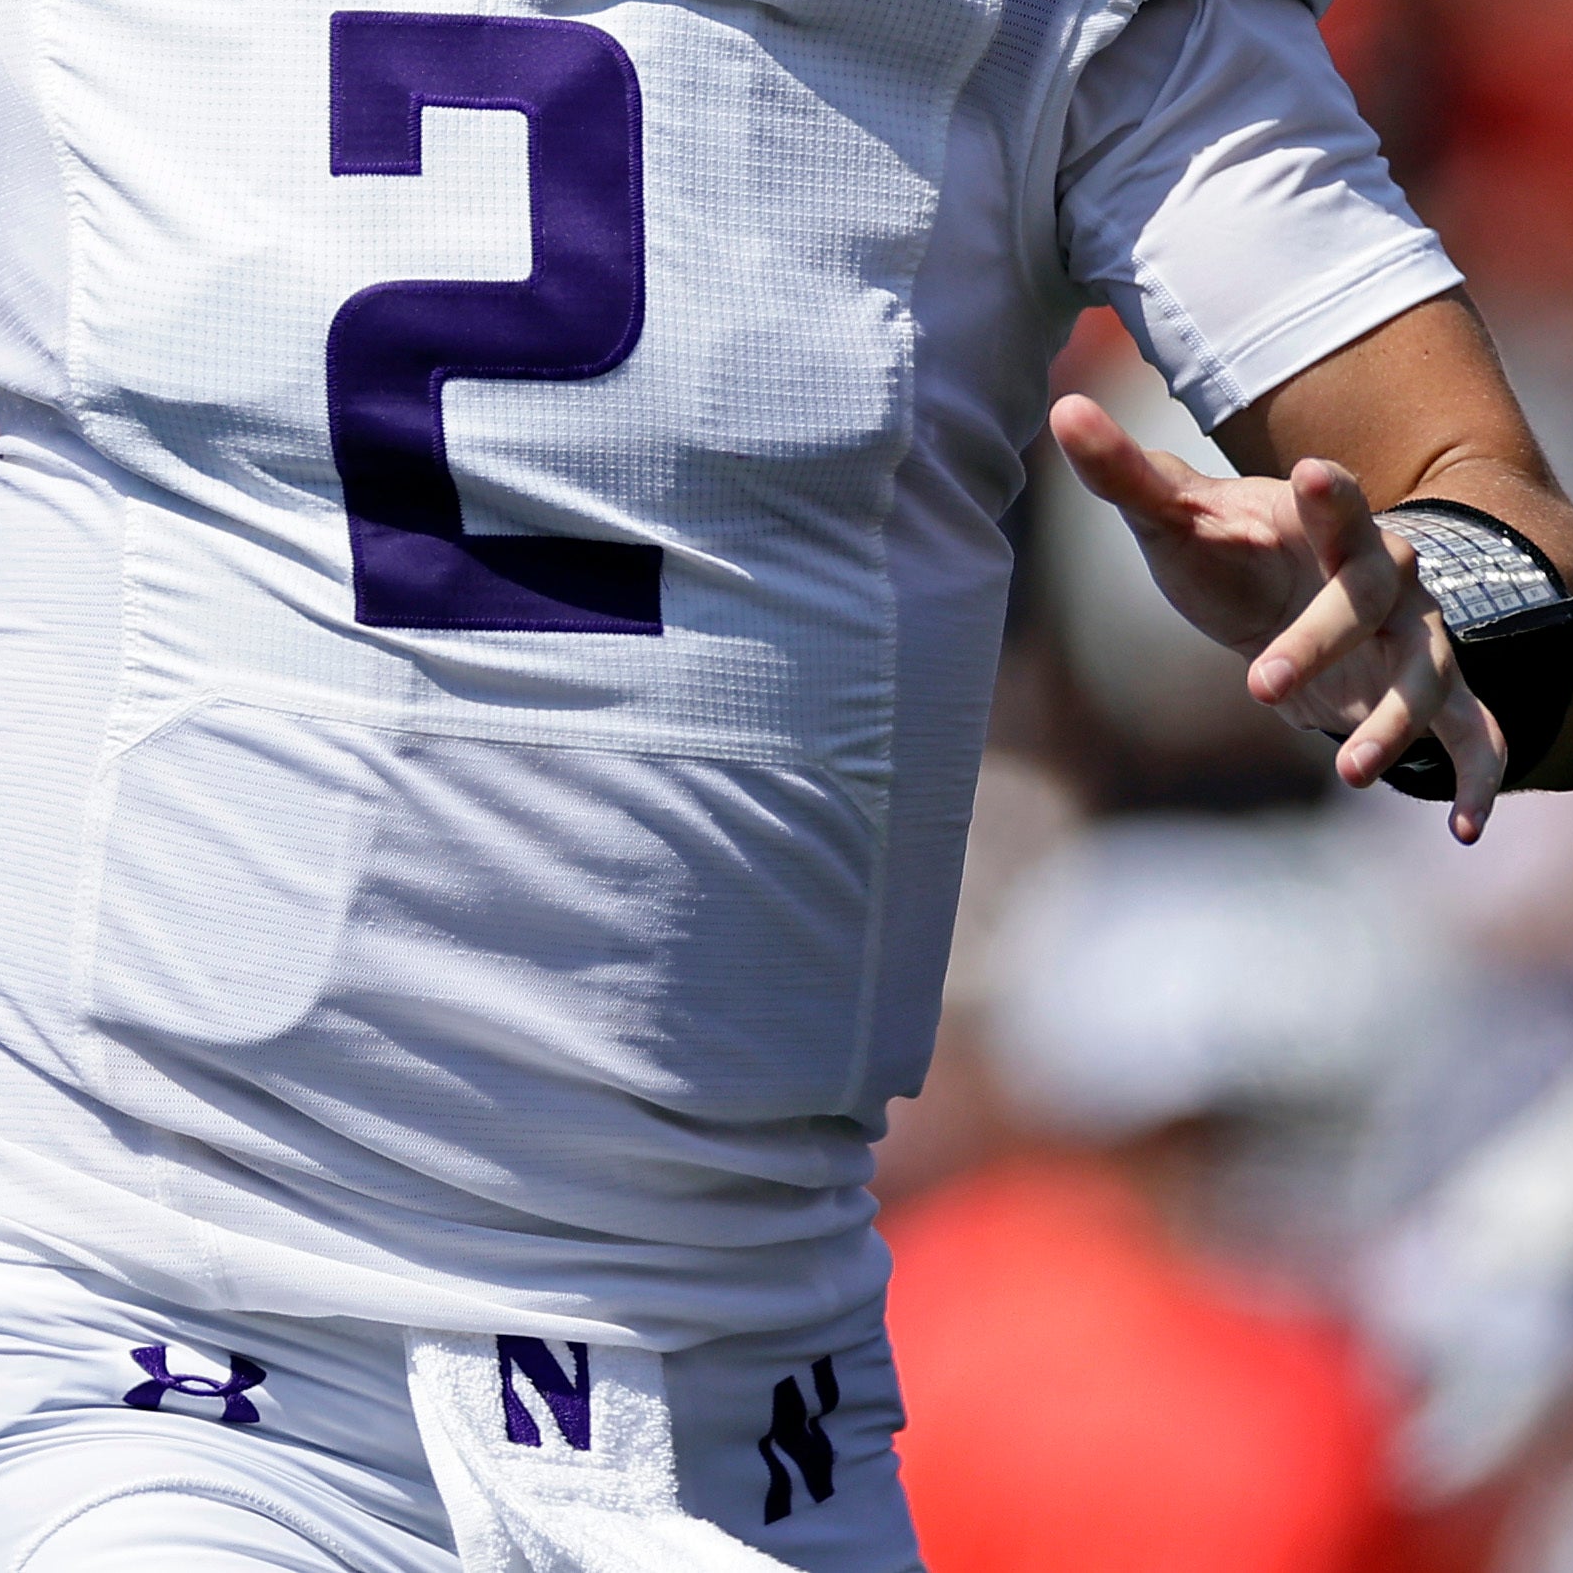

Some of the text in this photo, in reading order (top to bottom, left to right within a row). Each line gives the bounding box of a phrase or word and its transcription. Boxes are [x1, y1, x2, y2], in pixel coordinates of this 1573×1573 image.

[326, 11, 663, 634] 2
[496, 1334, 592, 1451] N
[759, 1354, 841, 1526] N
